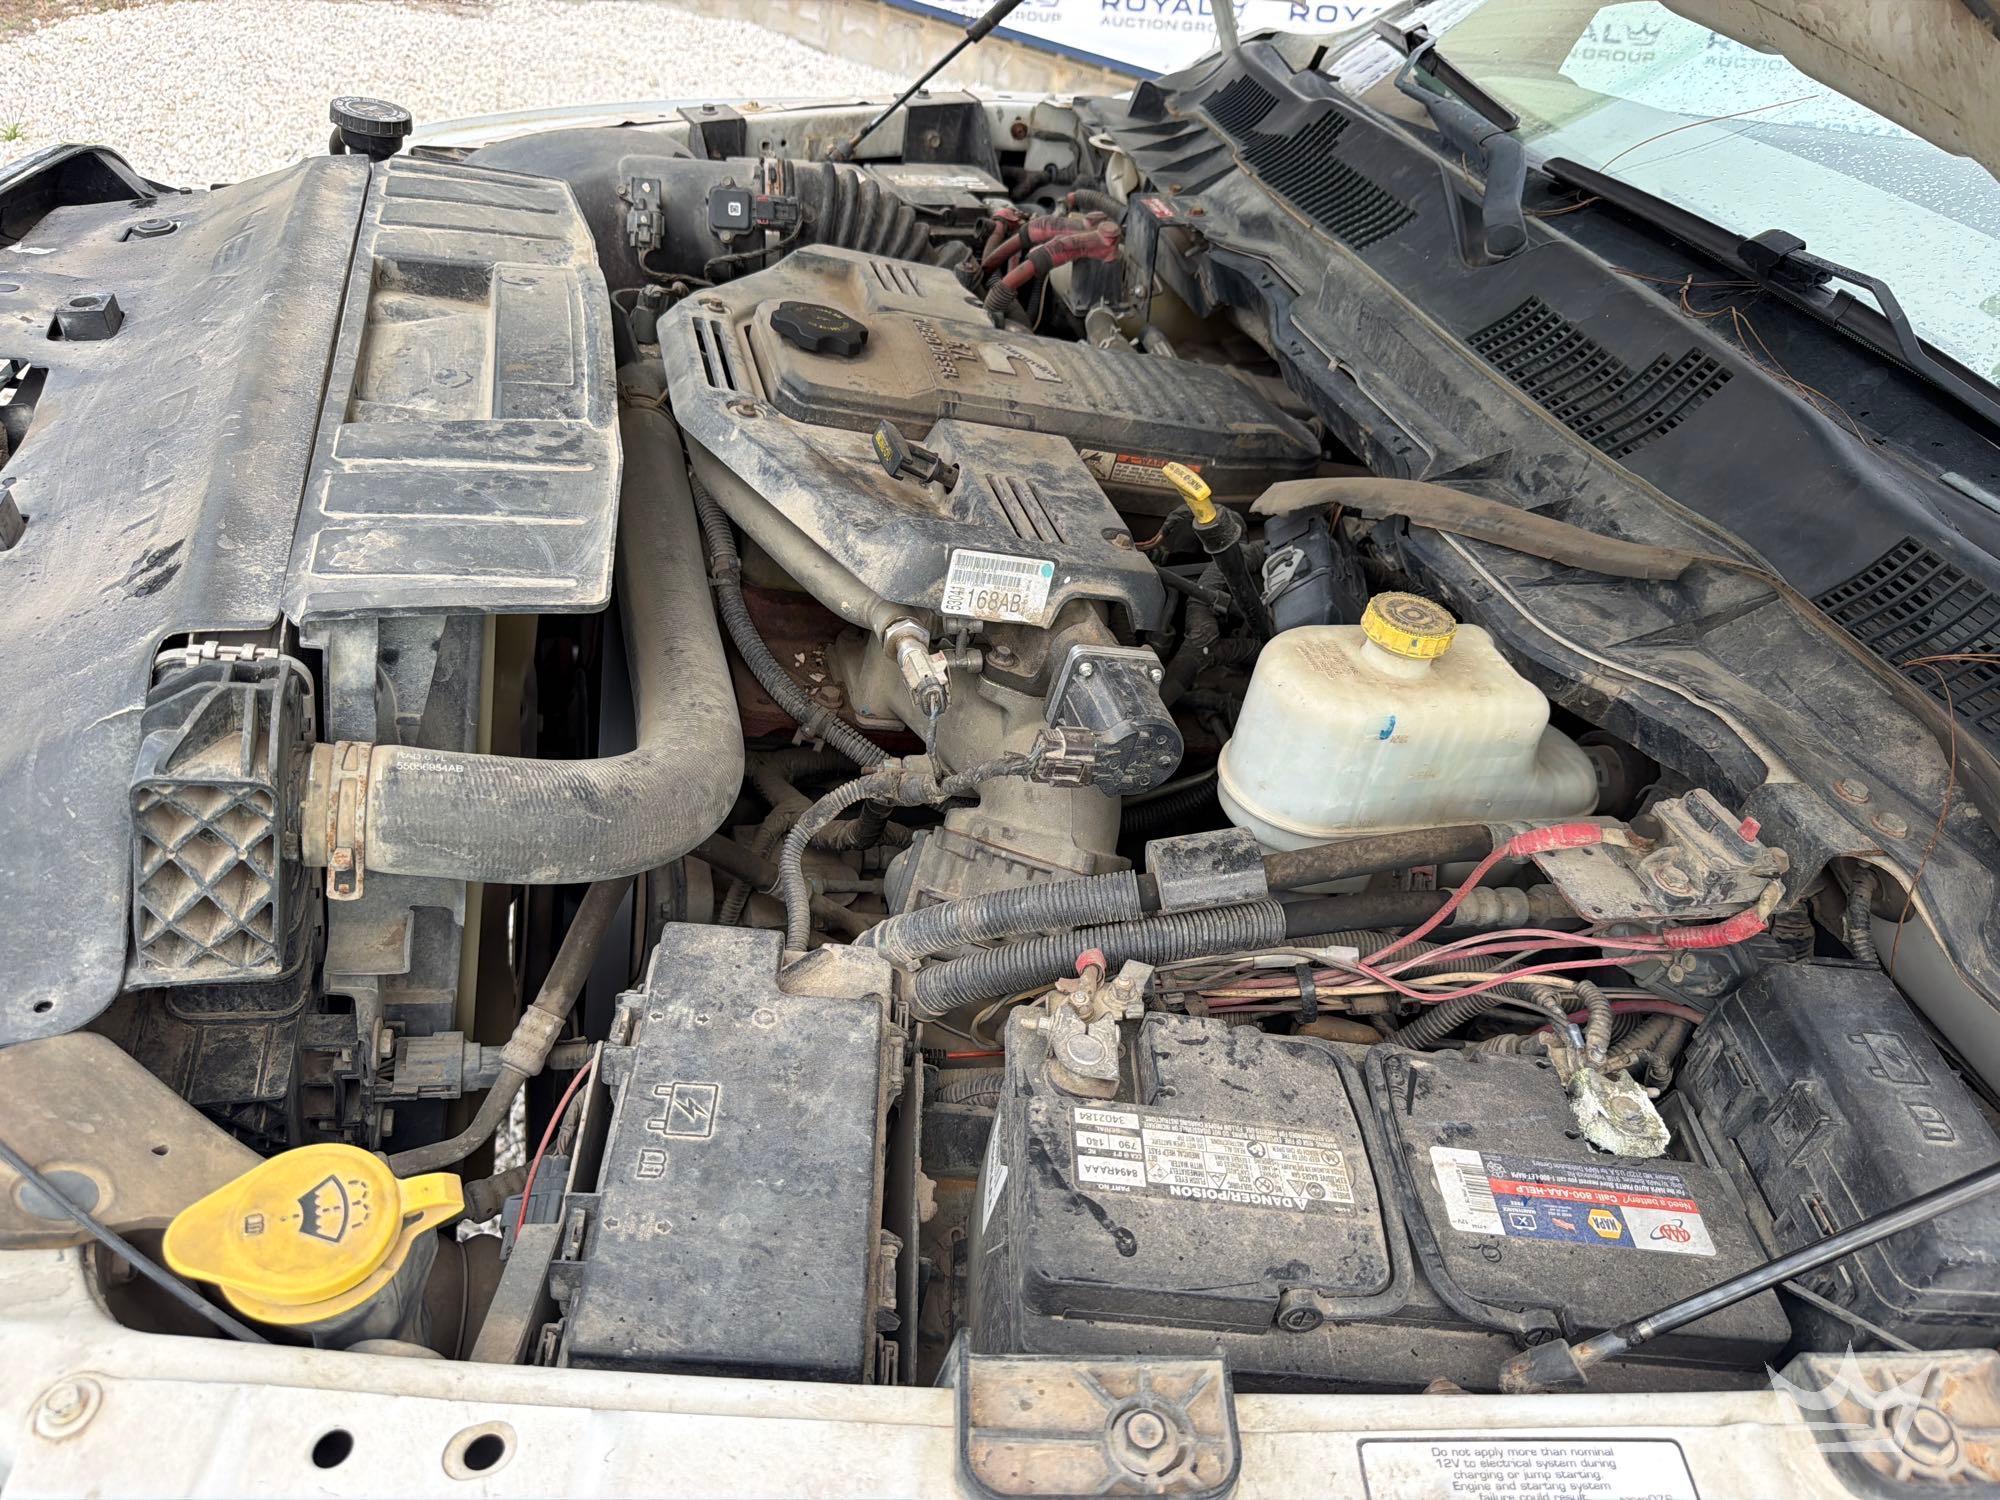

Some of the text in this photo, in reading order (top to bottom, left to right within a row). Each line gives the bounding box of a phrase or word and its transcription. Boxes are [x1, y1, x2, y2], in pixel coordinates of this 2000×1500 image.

[1100, 17, 1177, 30] AUCTION
[968, 588, 1022, 613] 168AB
[1080, 1112, 1125, 1125] 3402184
[1119, 1141, 1137, 1150] 790
[1084, 1164, 1138, 1178] 8494RAAA
[1515, 1185, 1593, 1201] 800-AAA-HELP
[1615, 1183, 1634, 1191] PARTS
[1170, 1185, 1294, 1208] DANGER/POISON
[1594, 1193, 1618, 1203] Call:
[1666, 1201, 1691, 1210] Need
[1591, 1216, 1619, 1231] NAPA
[1431, 1447, 1448, 1457] Do
[1452, 1447, 1471, 1457] not
[1474, 1447, 1504, 1459] apply
[1540, 1447, 1567, 1456] than
[1571, 1447, 1615, 1457] nominal
[1435, 1458, 1617, 1470] 12V to electrical system during
[1453, 1470, 1505, 1481] charging
[1507, 1471, 1520, 1479] or
[1524, 1470, 1552, 1480] jump
[1452, 1481, 1612, 1493] Engine and starting system
